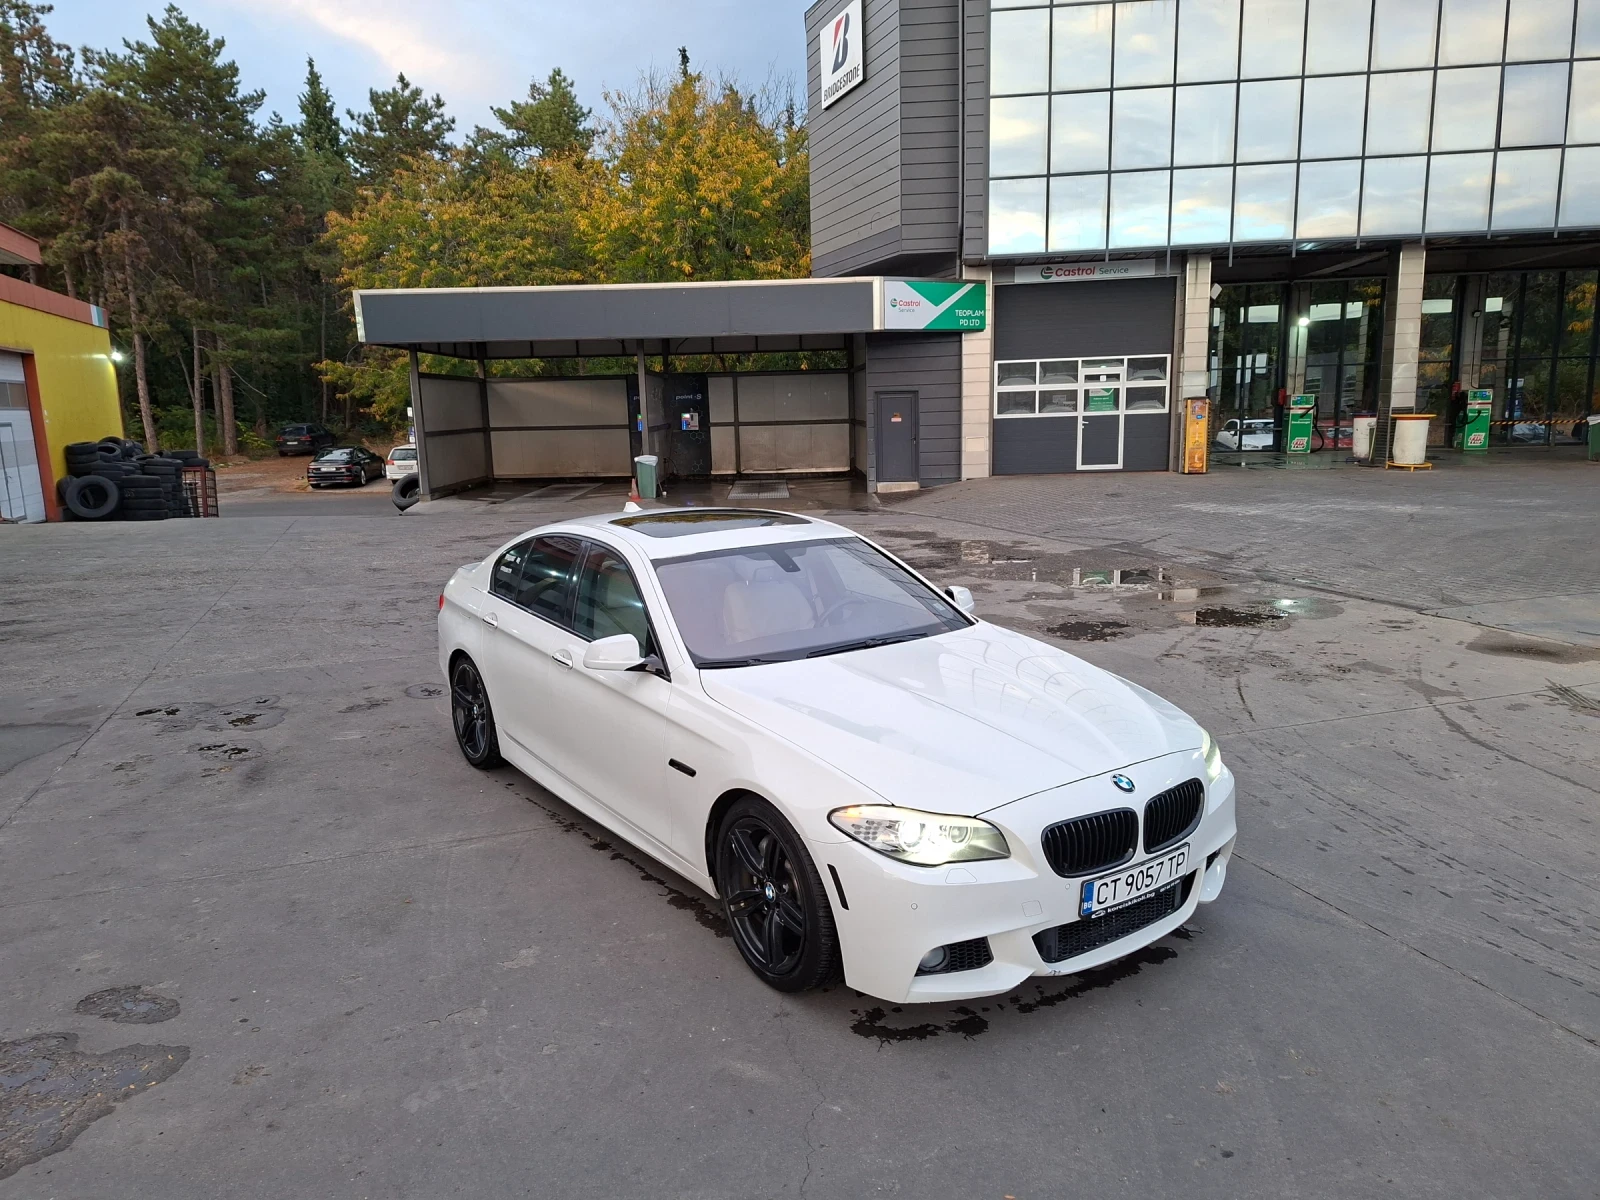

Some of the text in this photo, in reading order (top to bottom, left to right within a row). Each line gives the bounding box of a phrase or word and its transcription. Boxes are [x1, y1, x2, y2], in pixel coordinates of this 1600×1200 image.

[823, 63, 860, 102] BRIDGESTONE
[1055, 266, 1129, 277] Castrol Service
[1097, 878, 1121, 904] CT
[1125, 861, 1164, 896] 9057
[1168, 852, 1185, 877] TP
[1083, 900, 1093, 909] BG
